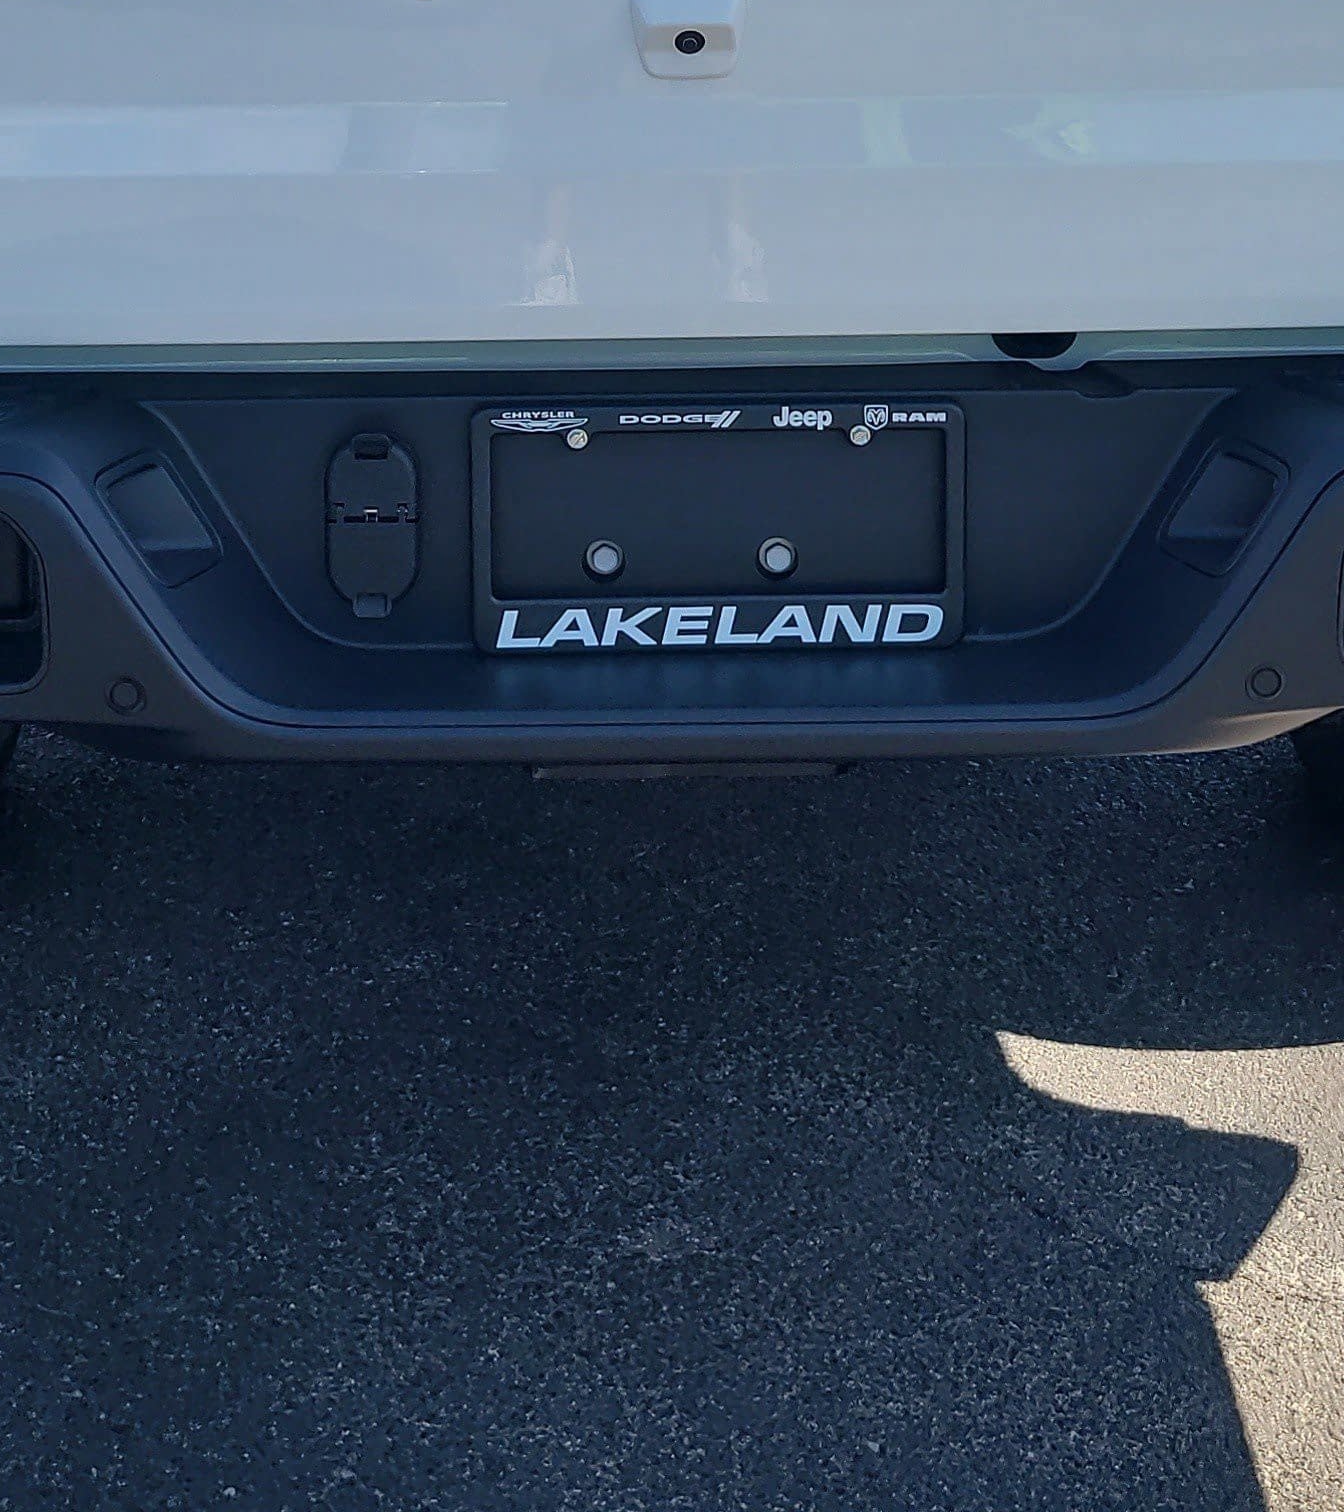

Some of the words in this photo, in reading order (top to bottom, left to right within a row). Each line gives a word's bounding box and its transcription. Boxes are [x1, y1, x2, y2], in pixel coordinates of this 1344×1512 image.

[501, 410, 575, 419] CHRYSLER
[619, 414, 726, 425] DODGE
[773, 406, 833, 430] Jeep
[892, 412, 947, 423] RAM
[496, 604, 944, 648] LAKELAND
